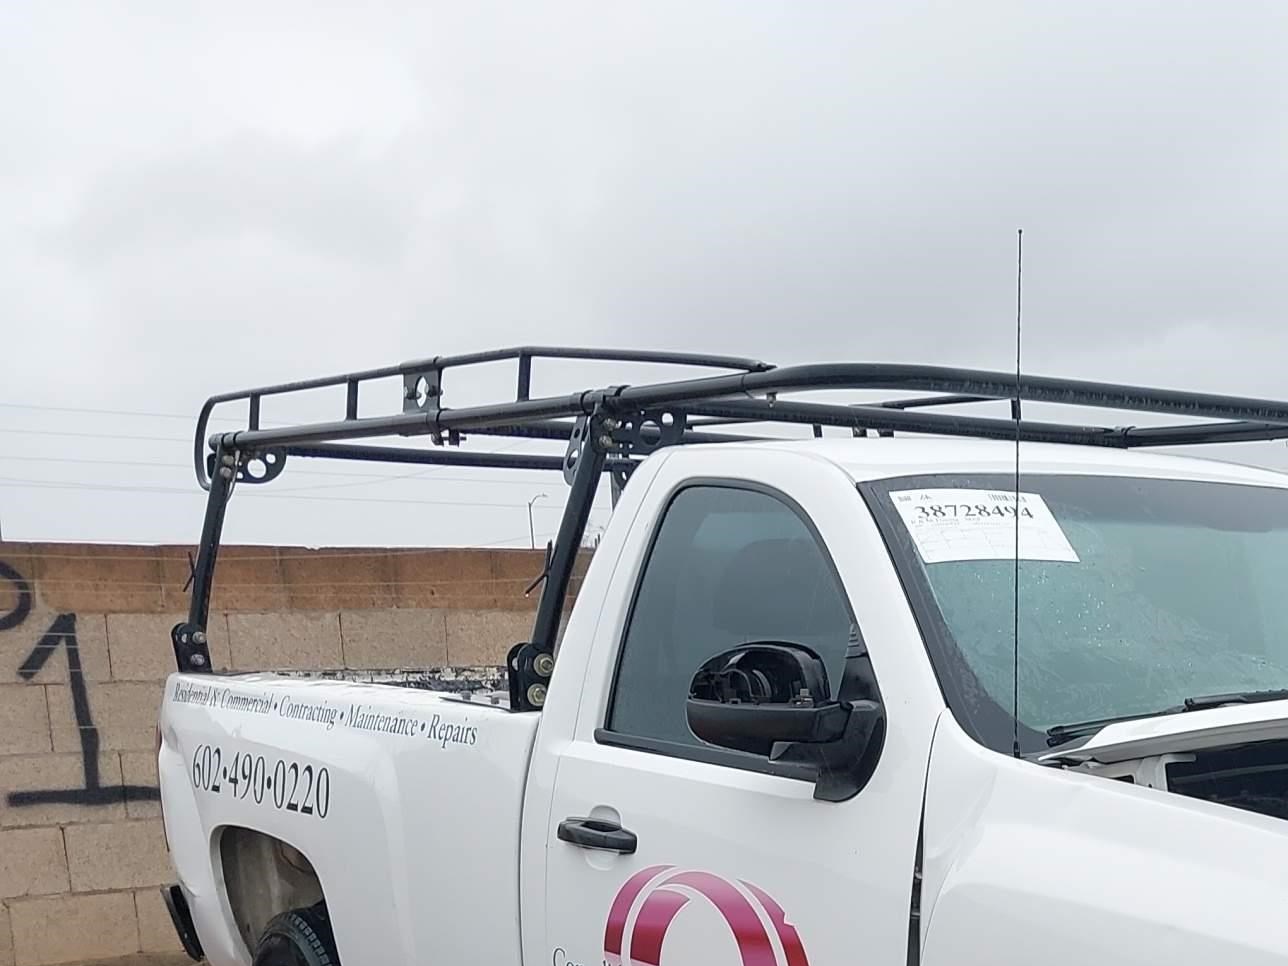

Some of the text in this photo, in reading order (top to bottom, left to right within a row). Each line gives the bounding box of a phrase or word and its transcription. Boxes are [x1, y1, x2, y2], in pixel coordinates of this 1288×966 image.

[915, 504, 1034, 519] 38728494
[173, 682, 211, 706] Residential
[221, 688, 274, 714] Commercial
[279, 695, 338, 731] Contracting
[345, 703, 418, 737] Maintenance
[427, 714, 478, 749] Repairs
